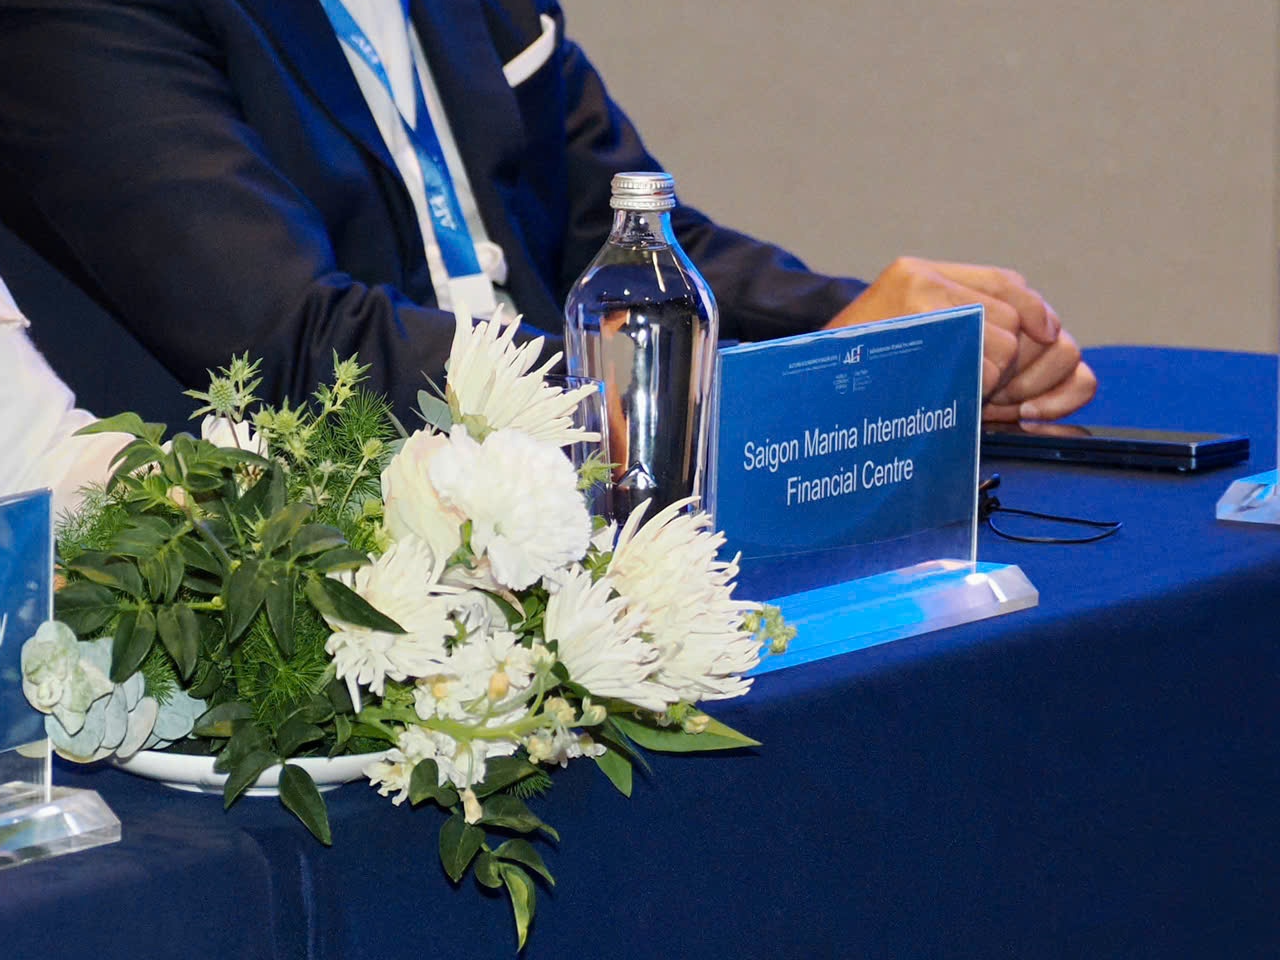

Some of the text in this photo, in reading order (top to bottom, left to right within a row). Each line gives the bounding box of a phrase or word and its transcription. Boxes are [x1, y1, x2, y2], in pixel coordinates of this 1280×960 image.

[743, 399, 957, 473] Saigon Marina International
[786, 456, 914, 506] Financial Centre
